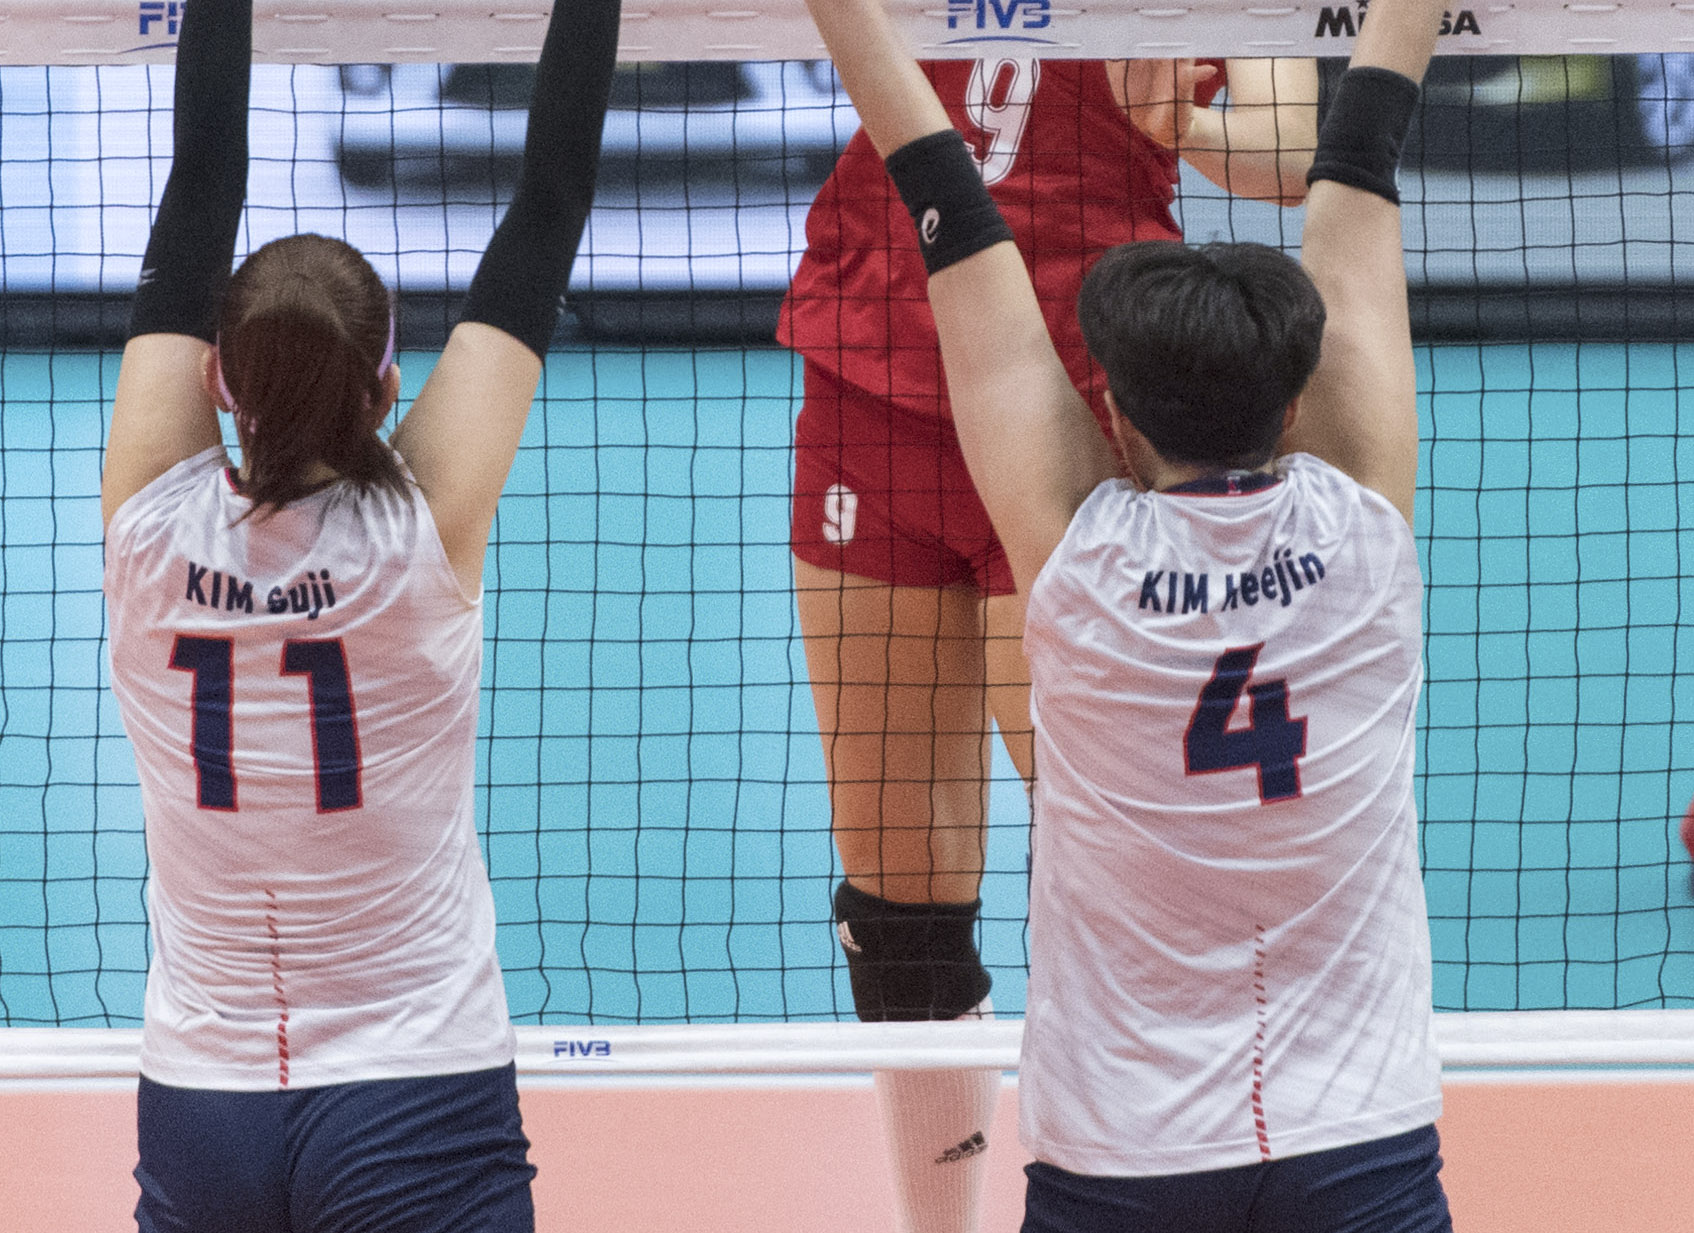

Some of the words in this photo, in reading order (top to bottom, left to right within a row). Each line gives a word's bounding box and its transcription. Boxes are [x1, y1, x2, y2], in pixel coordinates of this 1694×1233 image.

[962, 58, 1041, 187] 9
[822, 483, 859, 545] 9
[185, 561, 255, 615] KIM
[1137, 569, 1209, 615] KIM
[167, 633, 365, 815] 11
[1182, 641, 1309, 806] 4
[553, 1039, 612, 1058] FIVB
